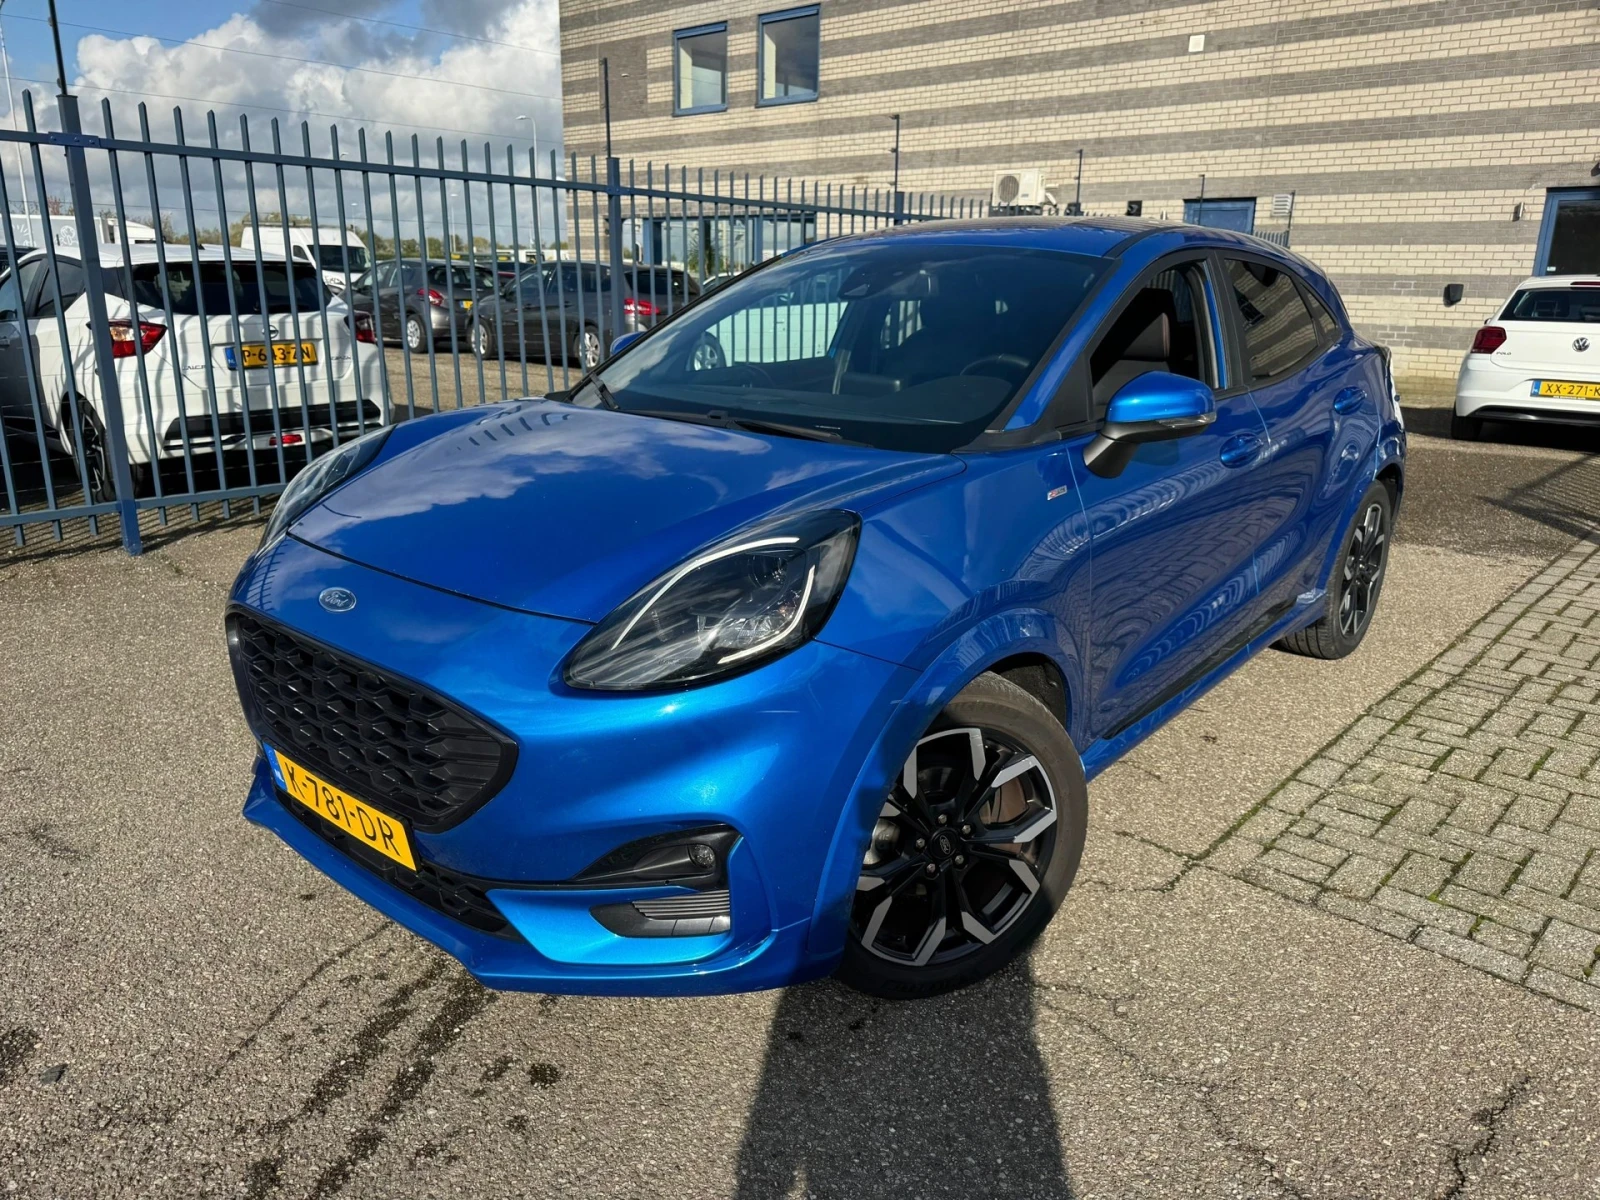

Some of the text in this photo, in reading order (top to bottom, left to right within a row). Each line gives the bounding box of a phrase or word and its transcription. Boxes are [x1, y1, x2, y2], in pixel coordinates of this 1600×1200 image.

[1545, 383, 1600, 397] XX-271-K
[325, 591, 349, 607] Ford
[285, 762, 402, 857] K-781-DR
